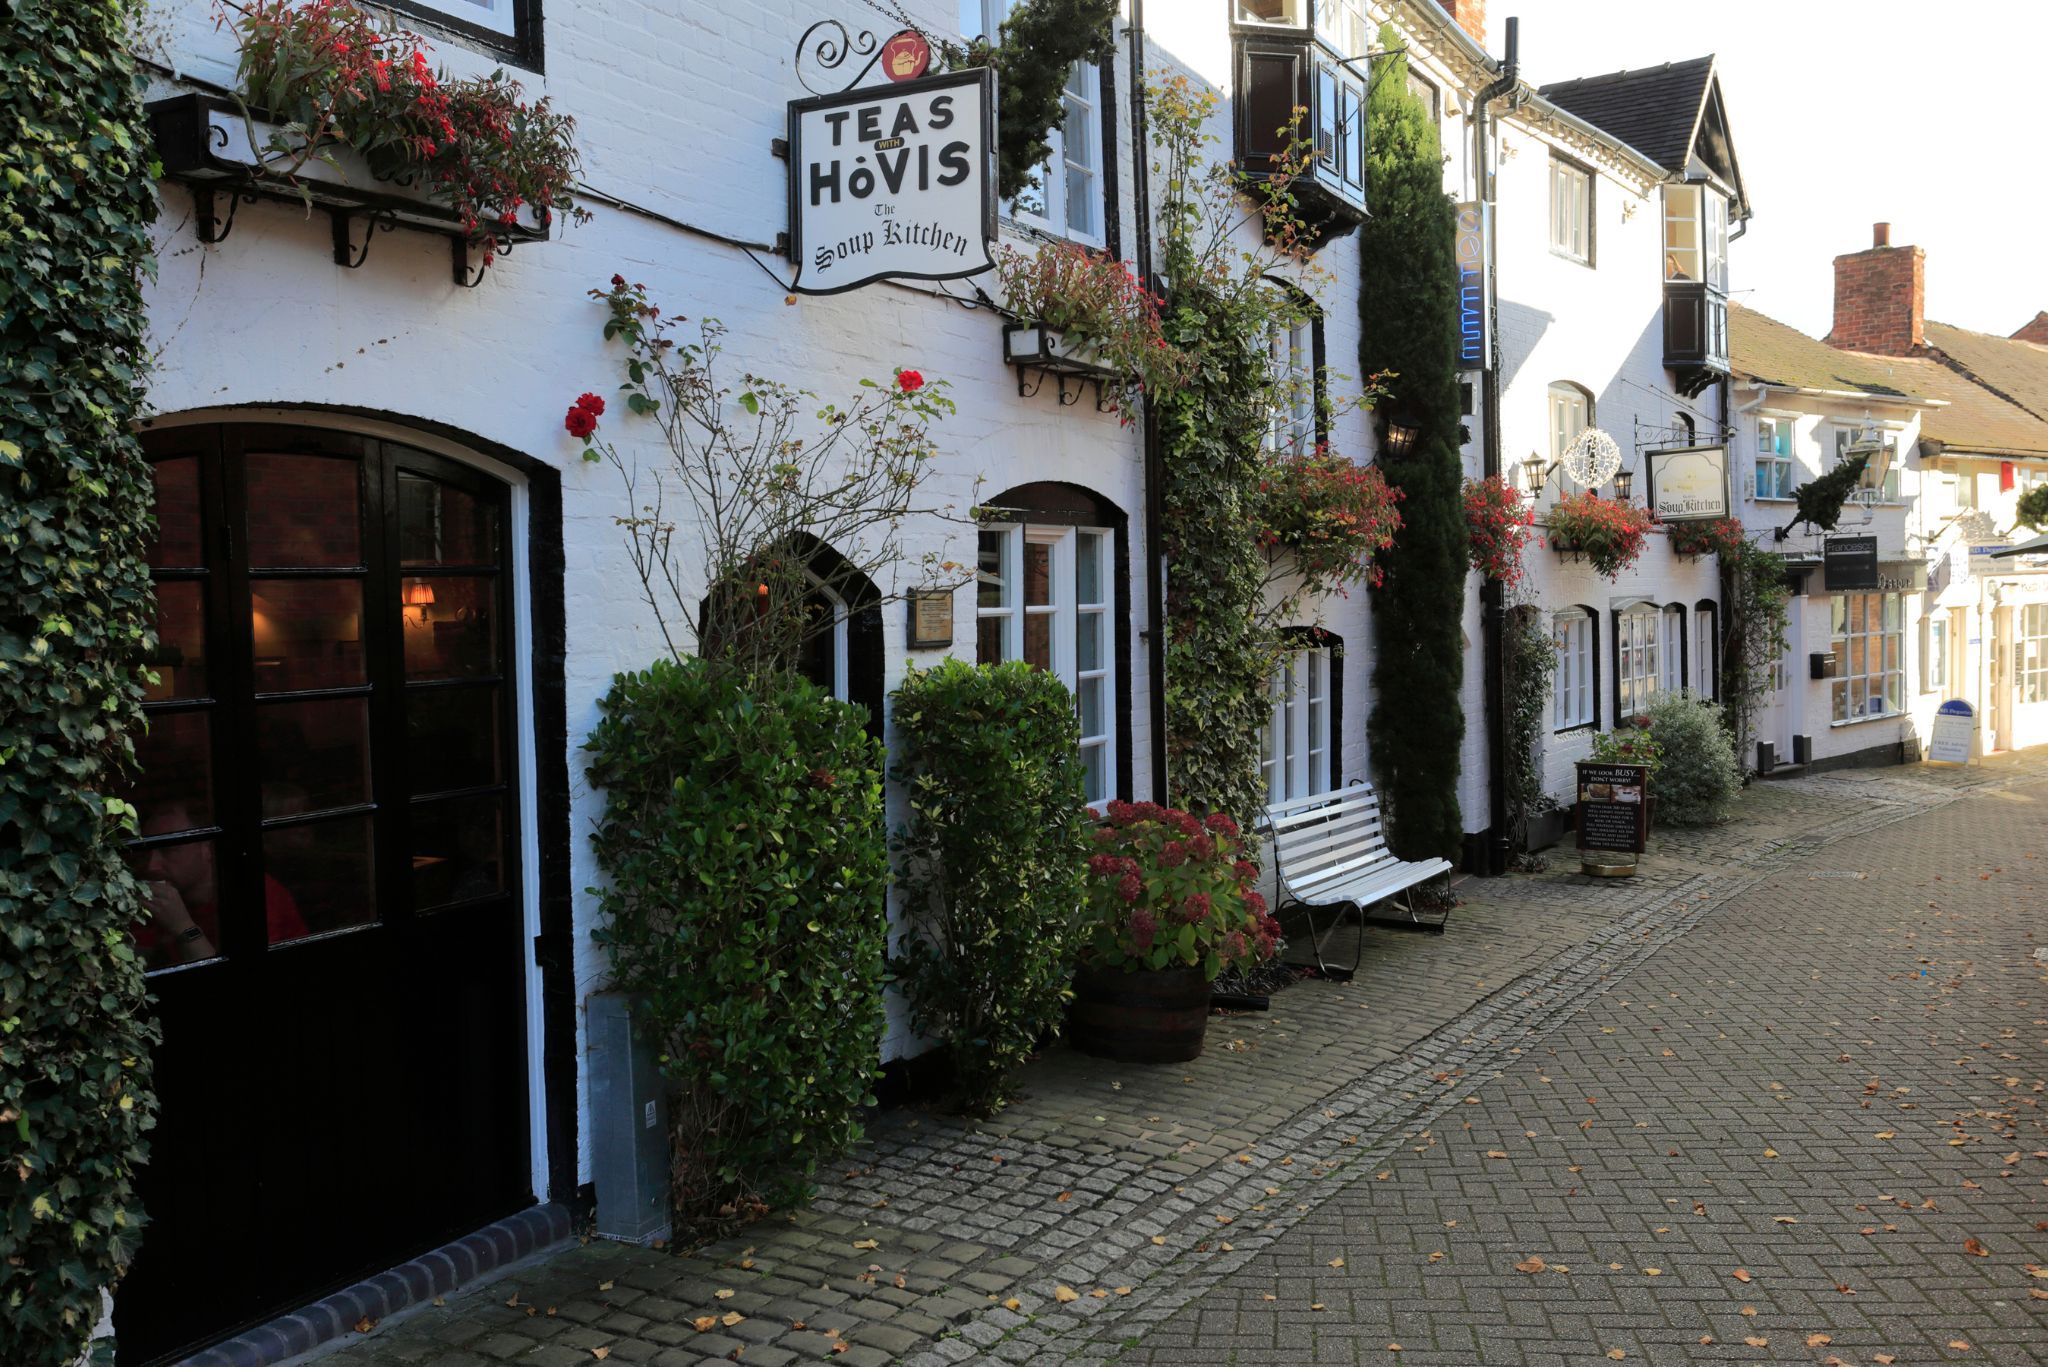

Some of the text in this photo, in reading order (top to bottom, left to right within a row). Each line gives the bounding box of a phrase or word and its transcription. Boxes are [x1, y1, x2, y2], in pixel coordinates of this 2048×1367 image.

[825, 96, 954, 146] TEAS
[878, 138, 900, 149] WITH
[874, 204, 896, 216] The
[814, 219, 968, 274] Soup Kitchen
[1659, 499, 1720, 514] Soup Kitchen
[1826, 542, 1874, 552] Francesco
